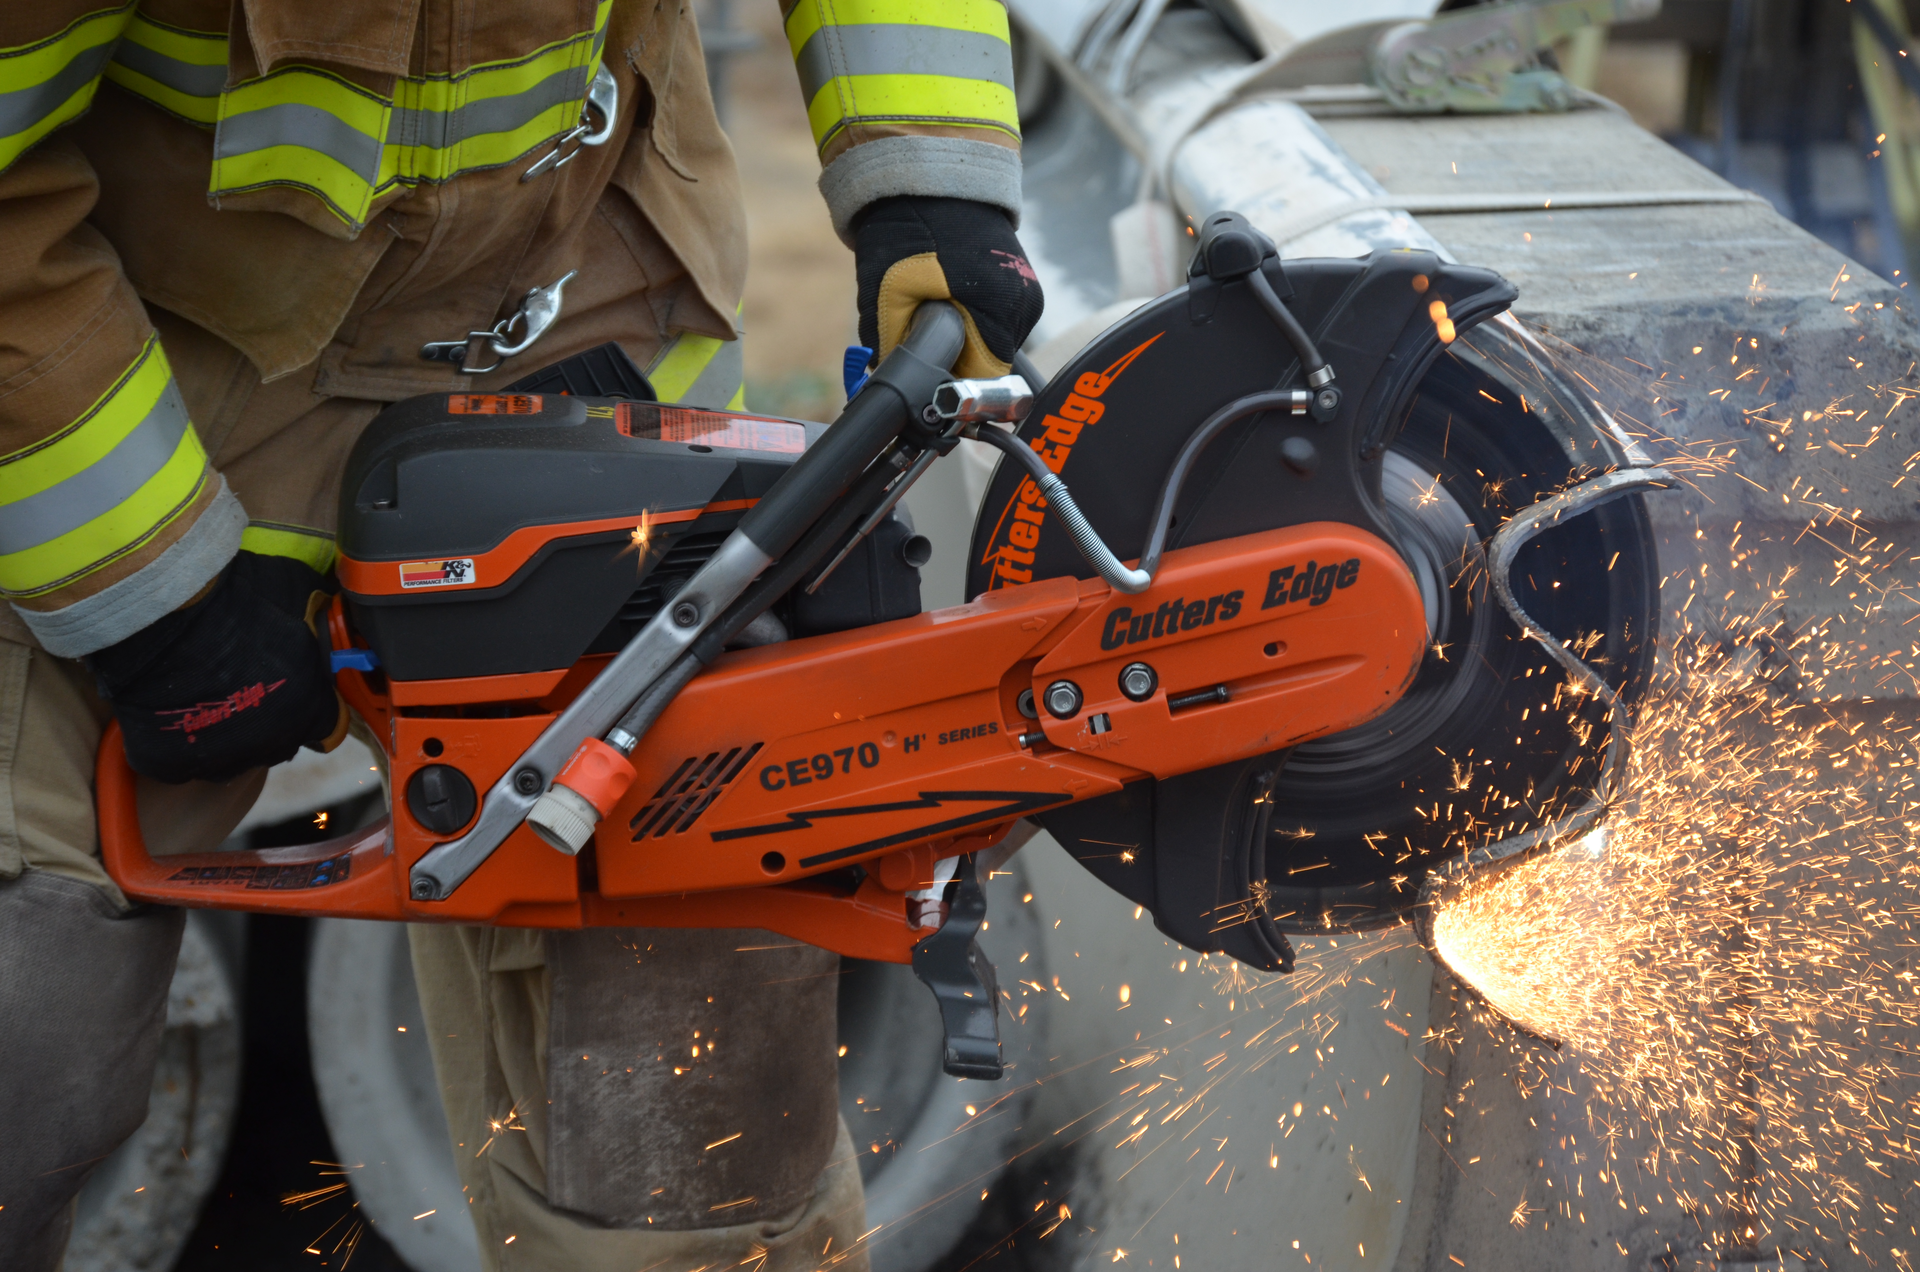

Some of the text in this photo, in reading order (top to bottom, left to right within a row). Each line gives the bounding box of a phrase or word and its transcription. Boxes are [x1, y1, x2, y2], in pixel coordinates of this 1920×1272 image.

[996, 371, 1110, 590] tters Edge
[403, 578, 442, 587] PERFORMANCE
[1100, 557, 1361, 652] Cutters Edge
[759, 741, 881, 792] CE970
[938, 721, 999, 746] SERIES
